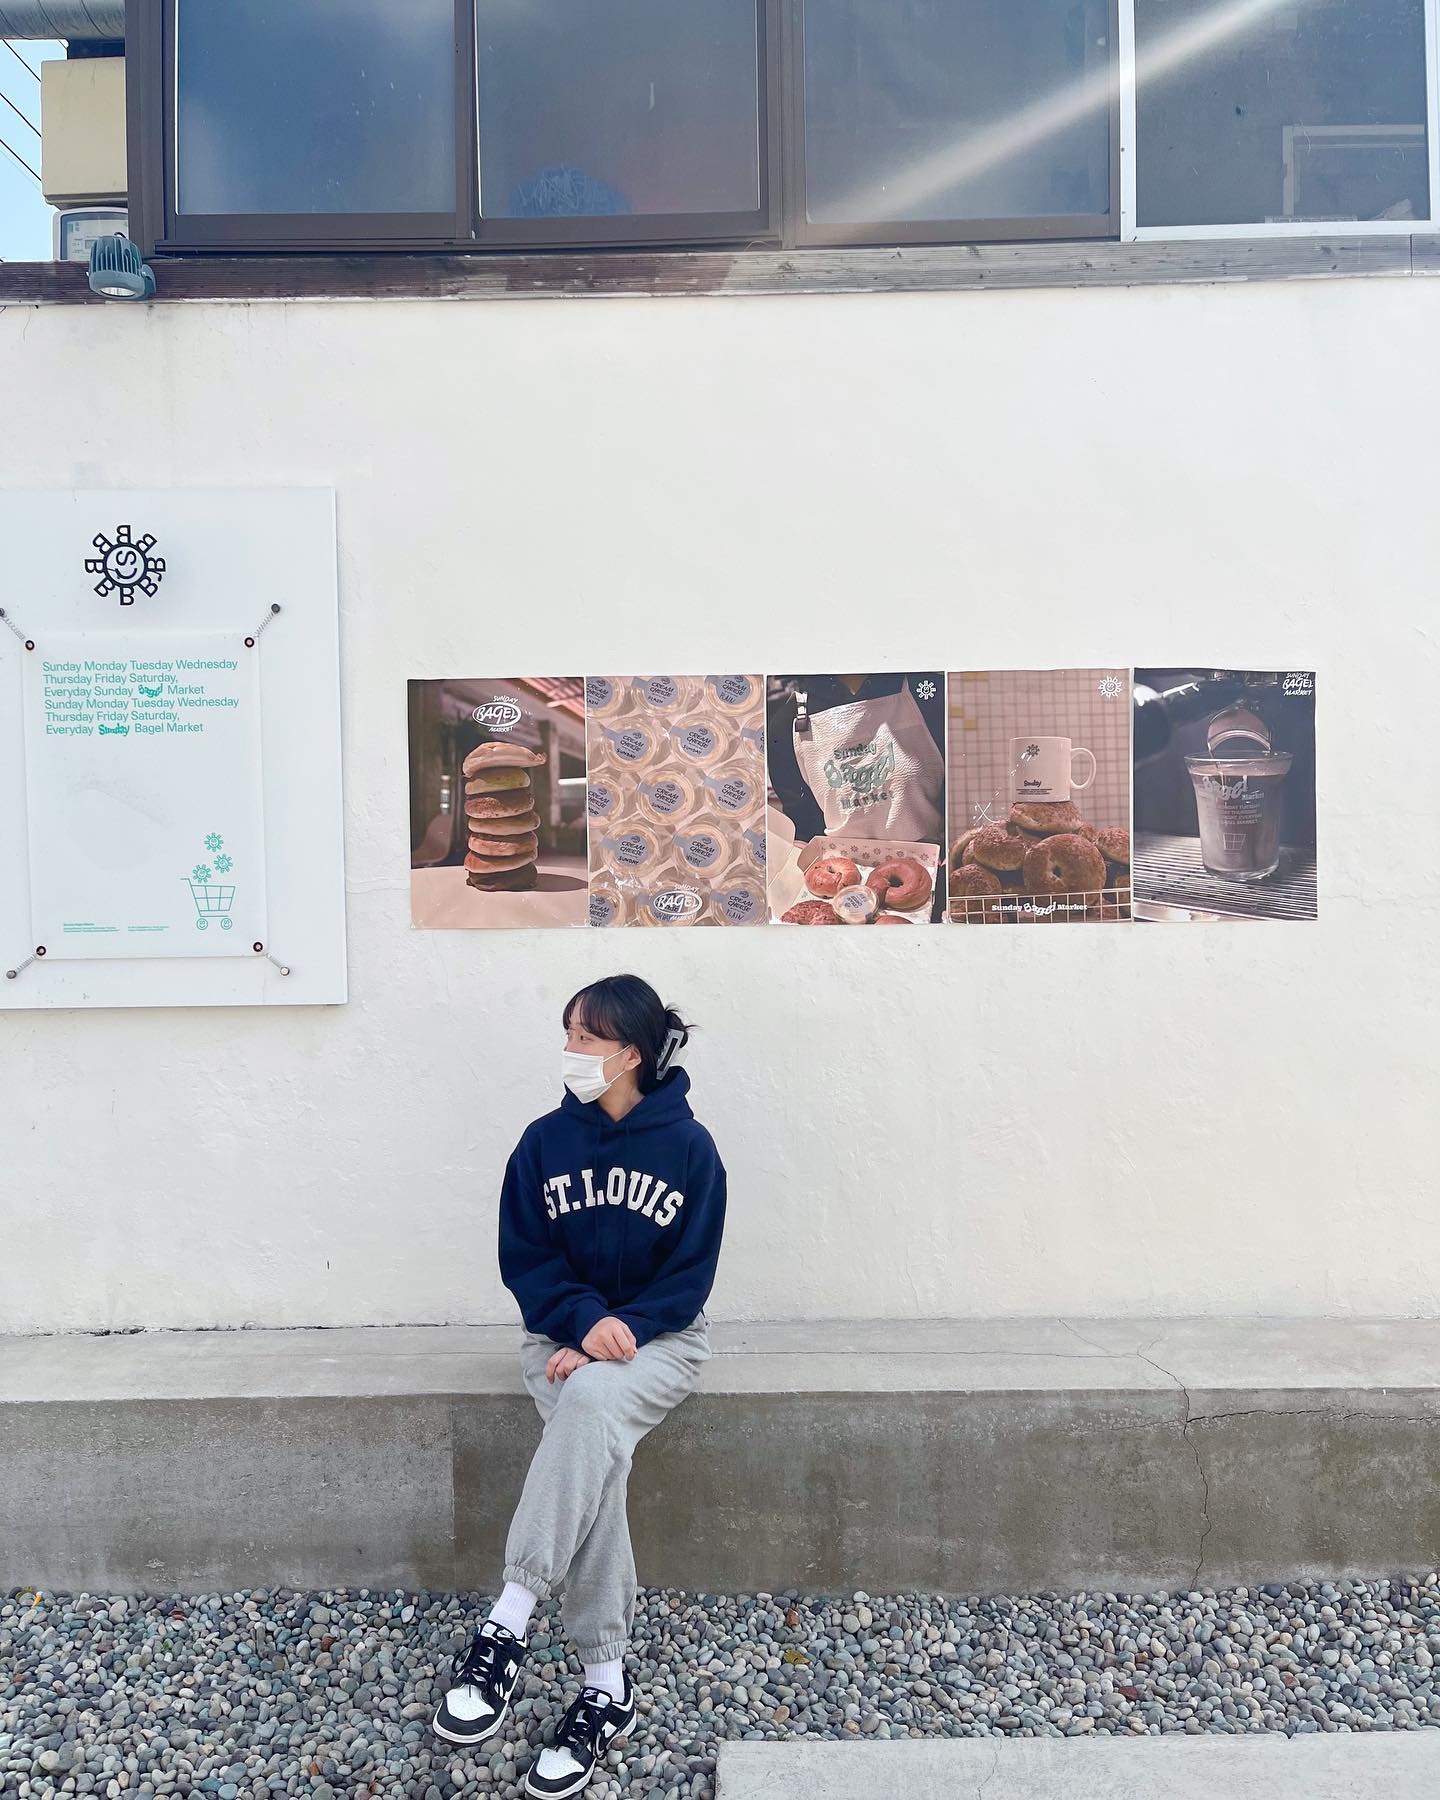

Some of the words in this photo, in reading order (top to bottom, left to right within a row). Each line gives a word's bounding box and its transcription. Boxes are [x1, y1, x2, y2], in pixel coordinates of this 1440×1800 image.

[43, 661, 82, 673] Sunday
[84, 660, 127, 672] Monday
[130, 660, 173, 671] Tuesday
[176, 659, 238, 670] Wednesday
[43, 674, 92, 685] Thursday
[95, 673, 127, 684] Friday
[129, 673, 178, 683] Saturday,
[1282, 678, 1314, 691] BAGEL
[44, 687, 93, 698] Everyday
[94, 686, 133, 697] Sunday
[167, 685, 205, 695] Market
[649, 686, 672, 697] CHEESE
[651, 682, 674, 693] CREAM
[722, 684, 744, 696] CHEESE
[724, 680, 747, 691] CREAM
[45, 700, 84, 711] Sunday
[86, 699, 129, 710] Monday
[131, 698, 175, 709] Tuesday
[178, 697, 239, 708] Wednesday
[493, 695, 518, 704] SUNDAY
[45, 712, 94, 723] Thursday
[97, 712, 129, 722] Friday
[131, 711, 179, 721] Saturday,
[476, 705, 518, 725] BAGEL
[46, 725, 94, 736] Everyday
[134, 723, 164, 735] Bagel
[167, 723, 203, 733] Market
[622, 735, 645, 747] CREAM
[686, 737, 709, 749] CHEESE
[688, 731, 711, 744] CREAM
[620, 740, 641, 752] CHEESE
[656, 788, 679, 800] CREAM
[721, 789, 744, 801] CHEESE
[724, 784, 747, 796] CREAM
[654, 793, 677, 804] CHEESE
[620, 847, 643, 856] CHEESE
[621, 841, 645, 850] CREAM
[692, 841, 715, 853] CREAM
[689, 846, 713, 858] CHEESE
[618, 856, 639, 865] SUNDAY
[727, 901, 752, 912] CHEESE
[729, 895, 753, 907] CREAM
[1057, 903, 1088, 911] Market
[589, 903, 610, 912] REAM
